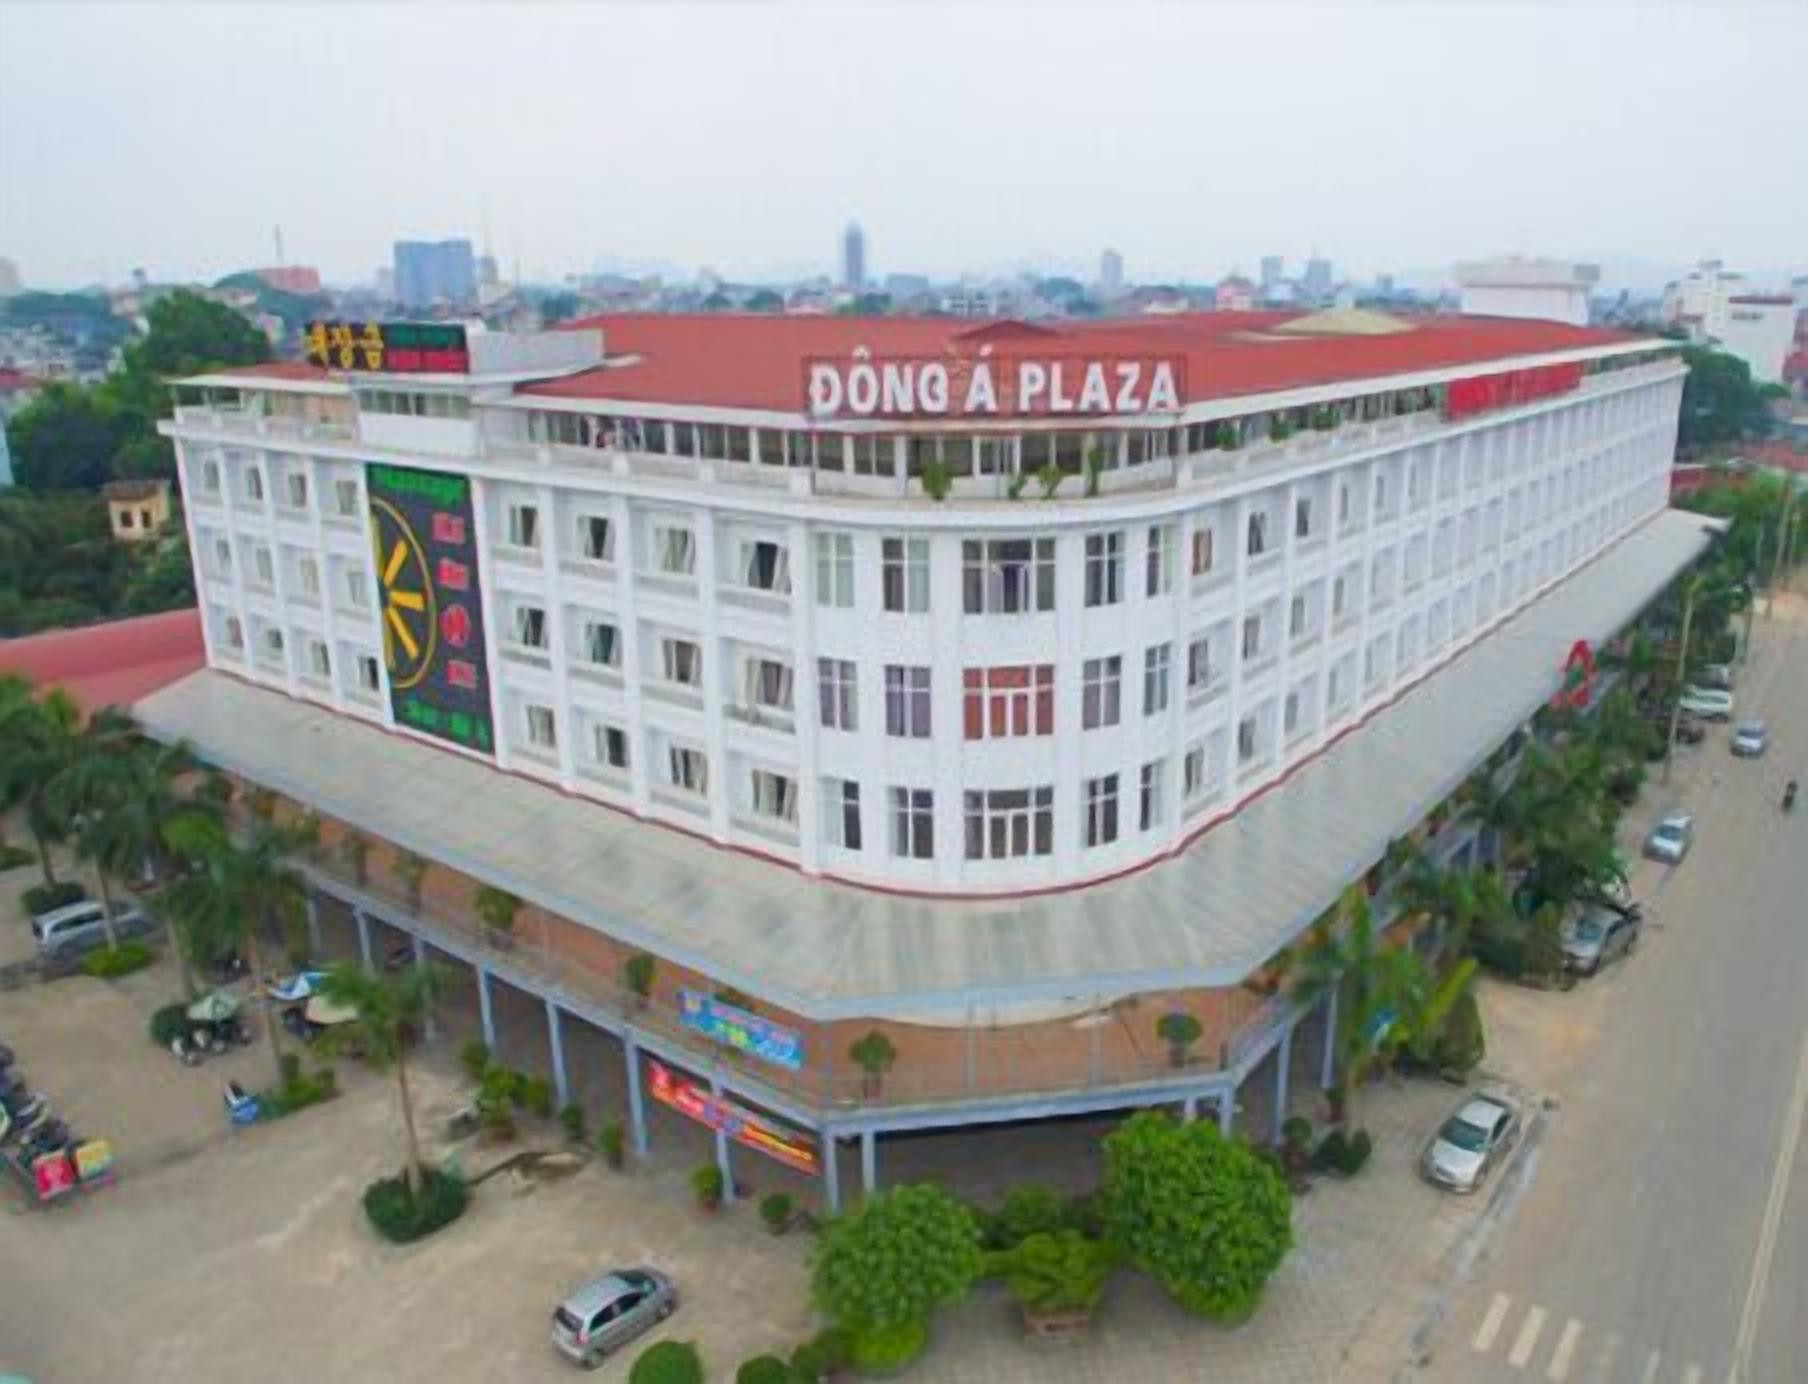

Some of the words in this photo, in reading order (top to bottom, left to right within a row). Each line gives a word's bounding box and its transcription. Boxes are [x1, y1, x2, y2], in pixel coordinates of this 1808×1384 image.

[809, 345, 949, 414] ĐÔNG
[964, 343, 998, 412] Á
[1018, 361, 1179, 412] PLAZA
